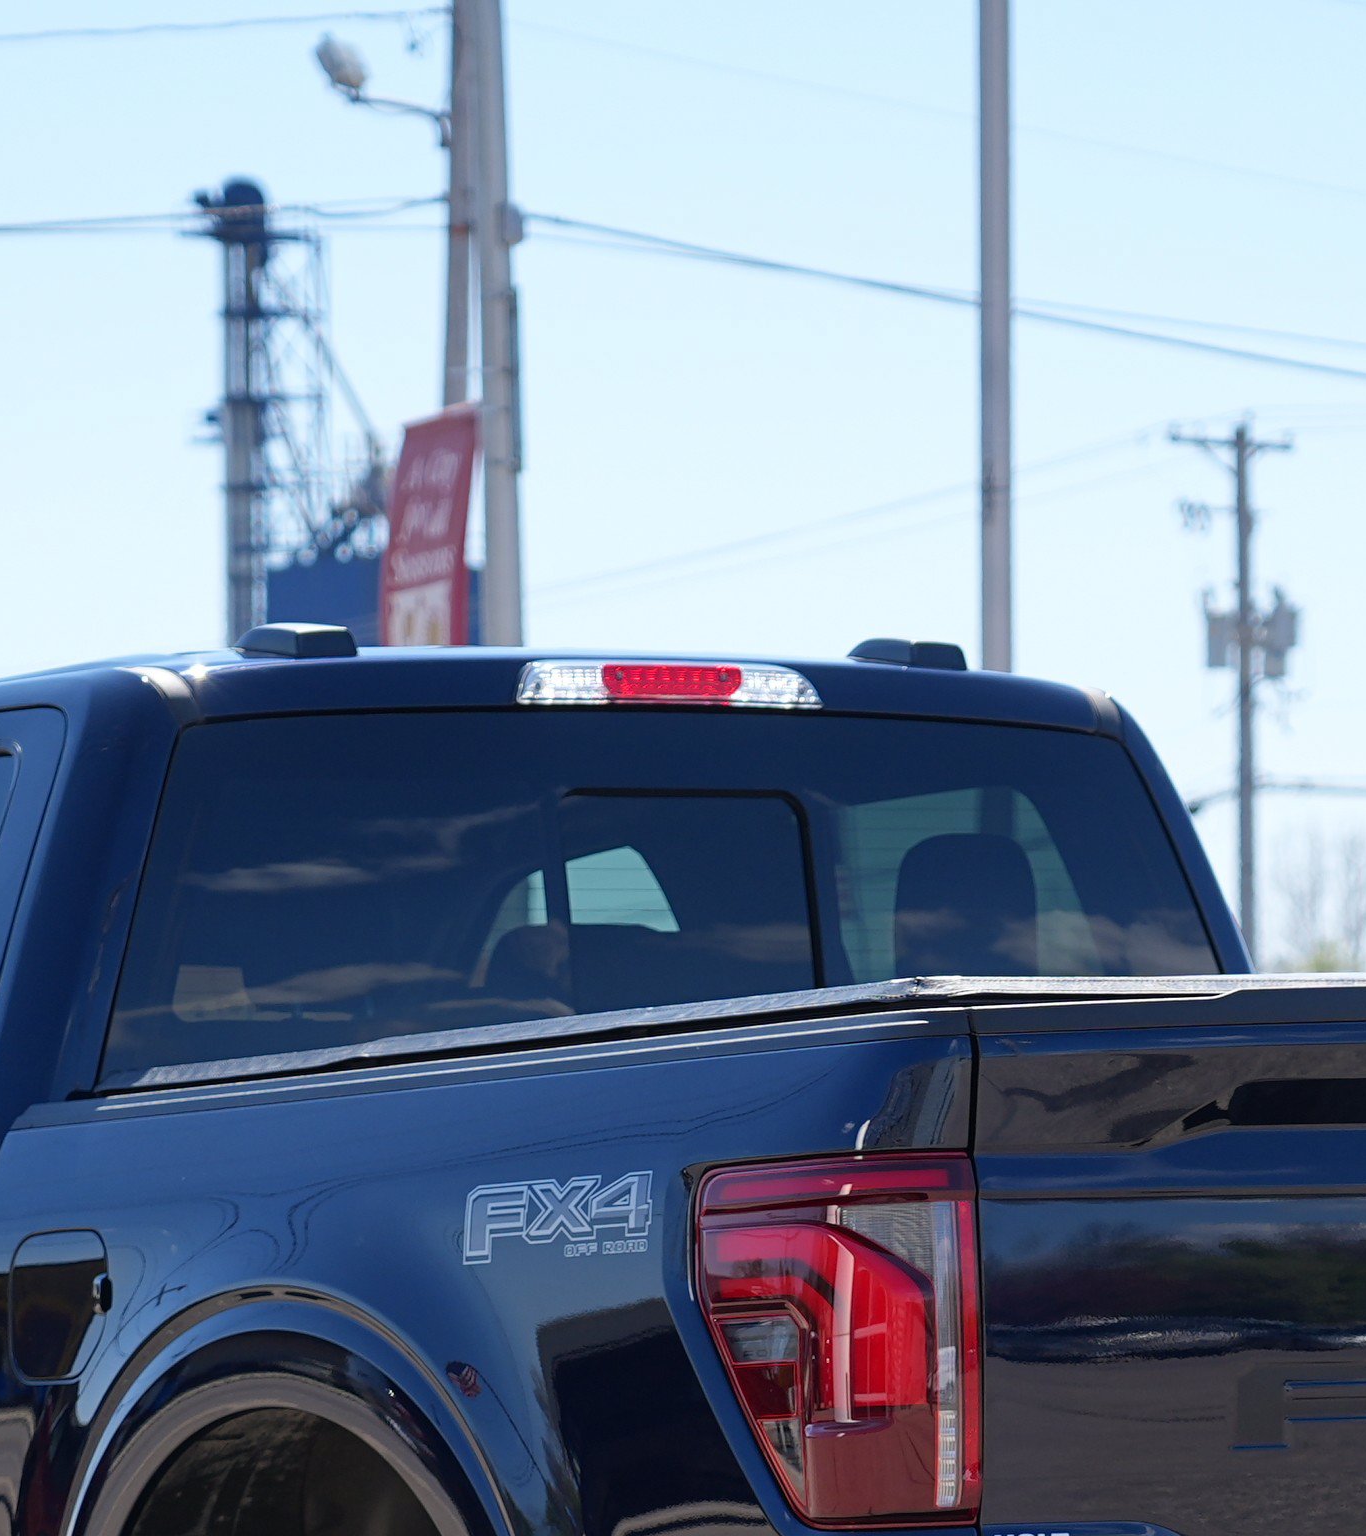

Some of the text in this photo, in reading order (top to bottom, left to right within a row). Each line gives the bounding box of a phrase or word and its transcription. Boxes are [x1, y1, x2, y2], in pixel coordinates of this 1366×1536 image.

[463, 1170, 653, 1265] FX4
[564, 1238, 649, 1258] OFF ROAD
